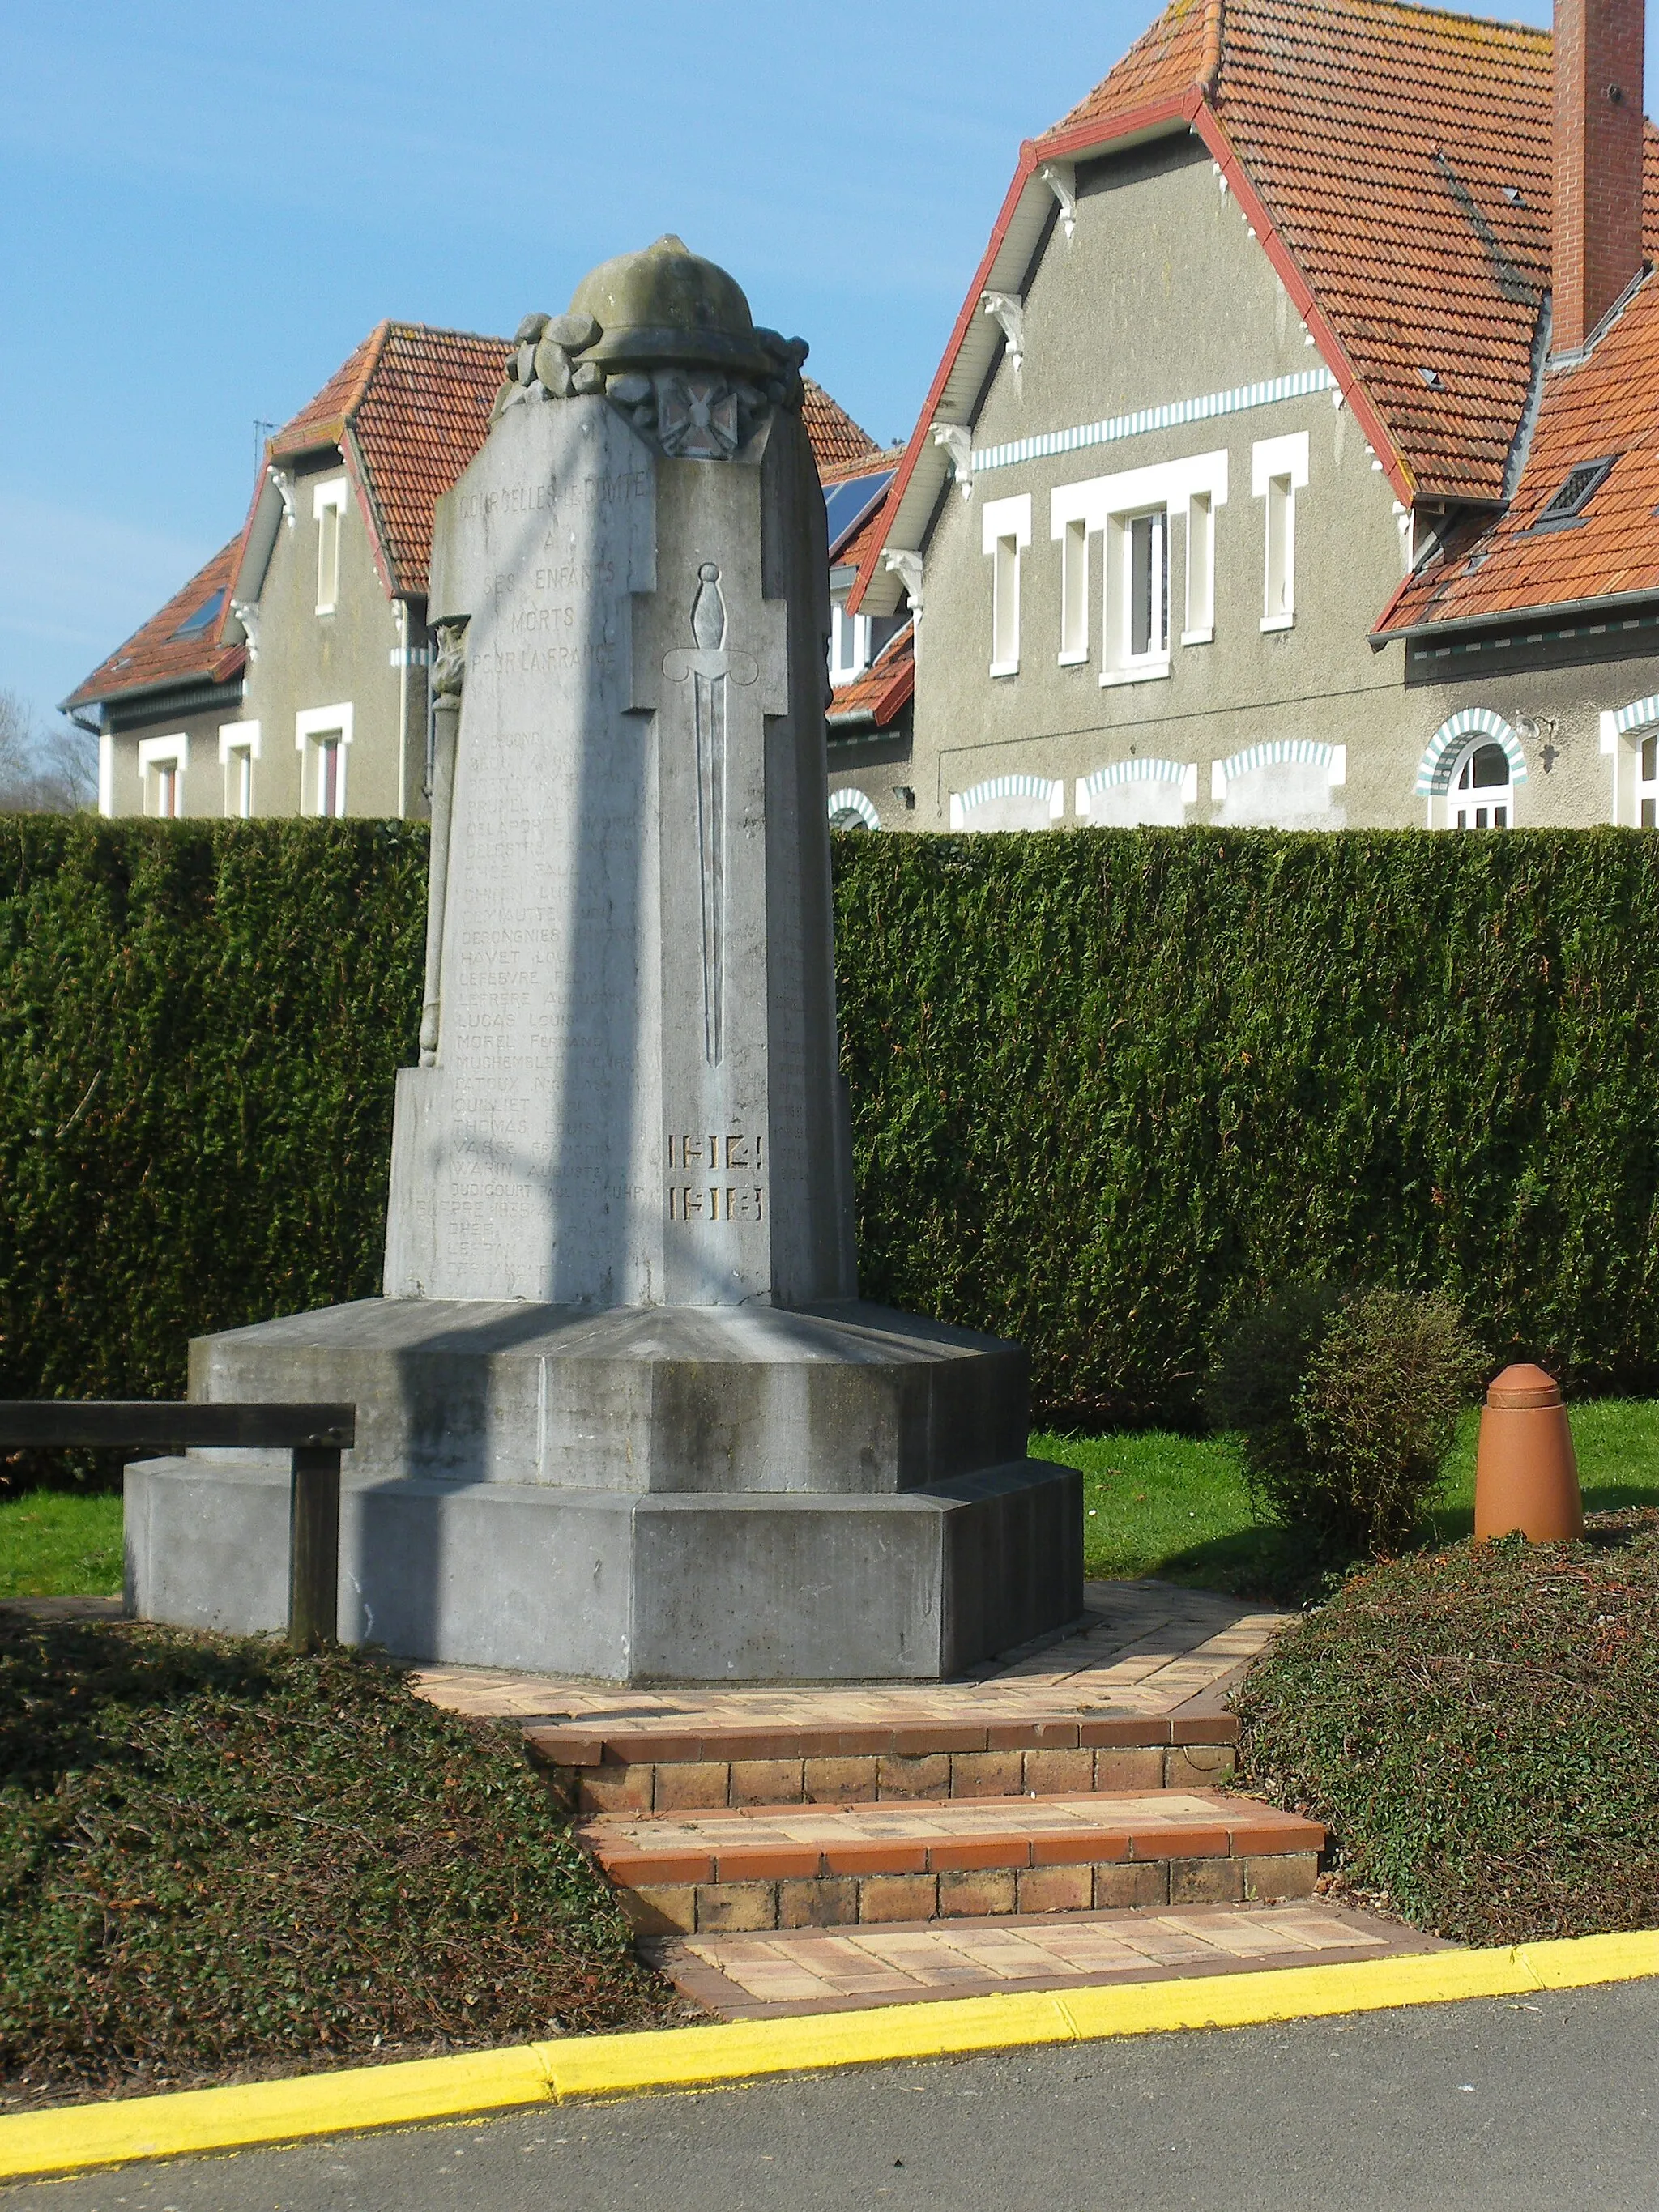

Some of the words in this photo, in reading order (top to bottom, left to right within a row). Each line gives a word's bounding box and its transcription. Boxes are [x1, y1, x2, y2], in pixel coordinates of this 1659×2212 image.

[484, 571, 516, 595] SES
[535, 560, 615, 590] ENFANTS
[511, 606, 574, 633] MORTS
[471, 650, 516, 674] POUR
[521, 649, 543, 671] LA
[547, 642, 616, 671] FRANCE
[462, 927, 561, 946] DESONGNIES
[459, 949, 521, 965] HAVET
[458, 970, 541, 987] LEFEBVRE
[458, 991, 531, 1008] LEFRERE
[457, 1012, 516, 1028] LUCAS
[529, 1011, 578, 1027] LOUIS
[456, 1034, 515, 1050] MOREL
[530, 1034, 603, 1049] FERNAND
[455, 1055, 565, 1071] MUCHEMBLED
[455, 1076, 519, 1092] PATOUX
[452, 1119, 527, 1136] THOMAS
[544, 1119, 595, 1136] LOUIS
[452, 1140, 518, 1156] VASSE
[668, 1134, 763, 1170] 1914
[450, 1161, 513, 1178] WARIN
[669, 1187, 763, 1221] 1918
